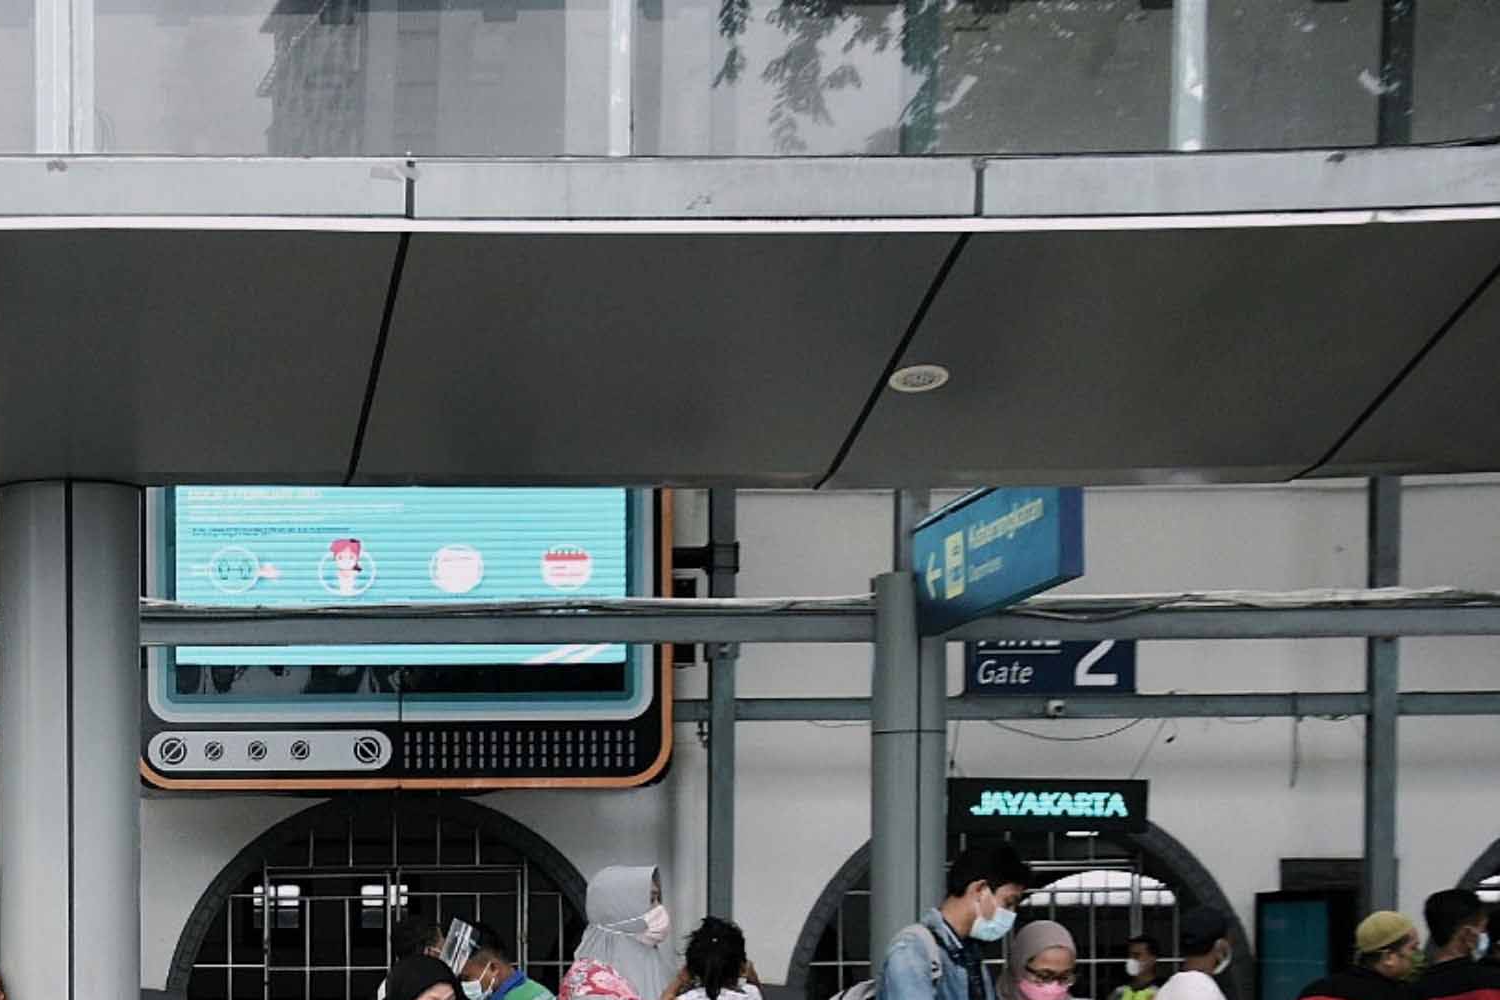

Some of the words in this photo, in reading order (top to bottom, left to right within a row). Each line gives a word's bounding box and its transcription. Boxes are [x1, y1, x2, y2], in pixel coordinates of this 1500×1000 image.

[977, 659, 1034, 685] Gate
[1074, 639, 1119, 687] 2
[969, 790, 1129, 818] JAYAKARTA
